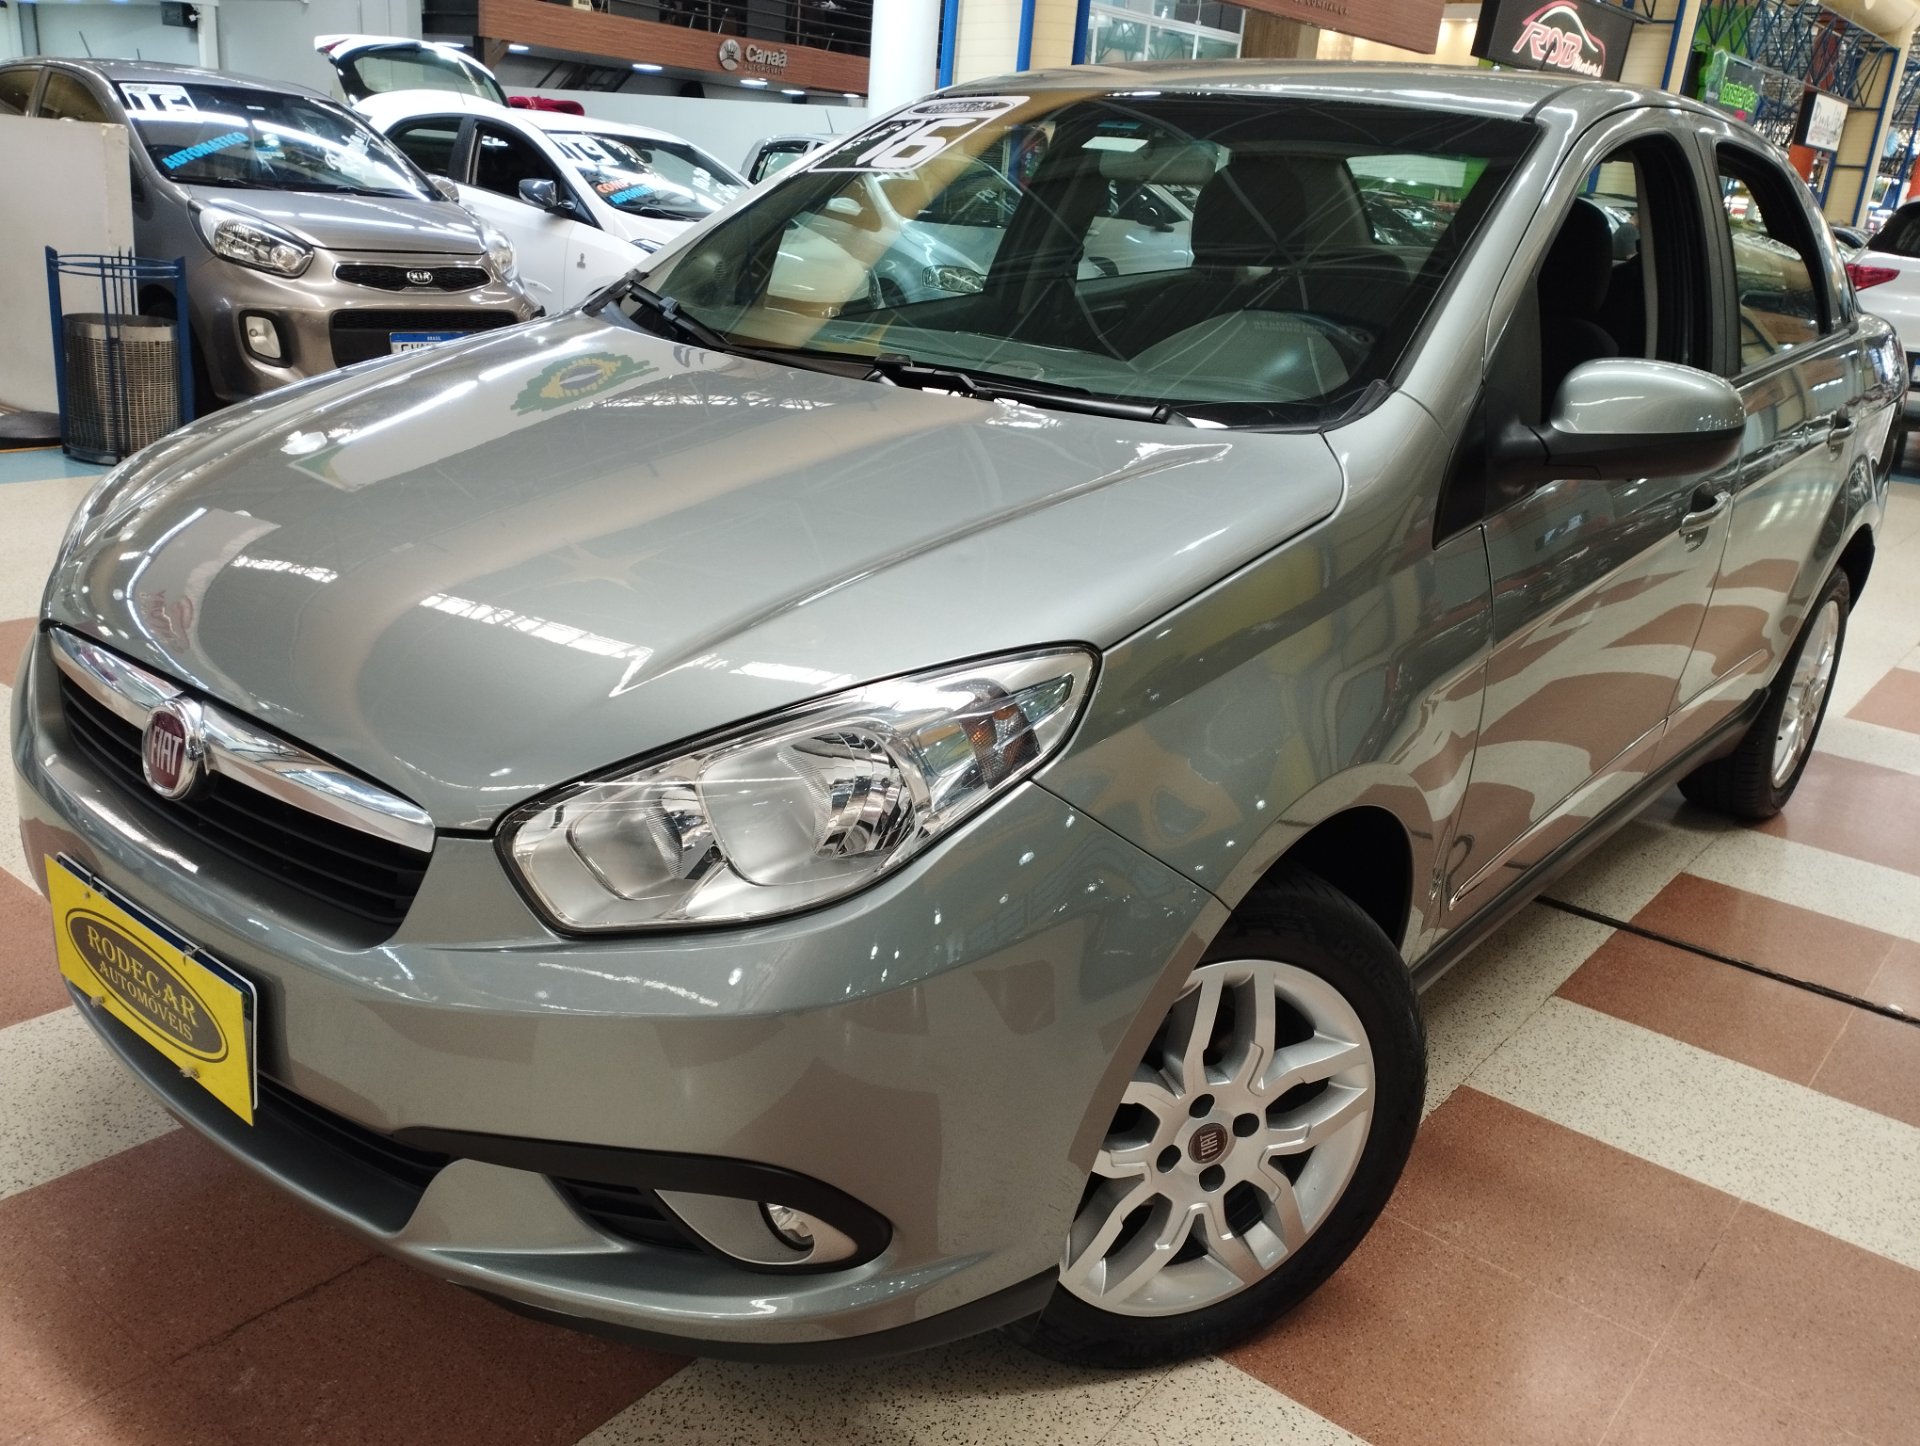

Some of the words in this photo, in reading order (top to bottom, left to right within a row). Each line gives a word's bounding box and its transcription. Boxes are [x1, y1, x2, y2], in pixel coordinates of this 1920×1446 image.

[746, 44, 787, 67] Canaã
[856, 117, 977, 169] 16
[151, 725, 184, 776] FIAT
[87, 925, 200, 1028] RODECAR
[99, 960, 194, 1042] AUTOMÓVEIS
[1199, 1132, 1218, 1157] FIAT
